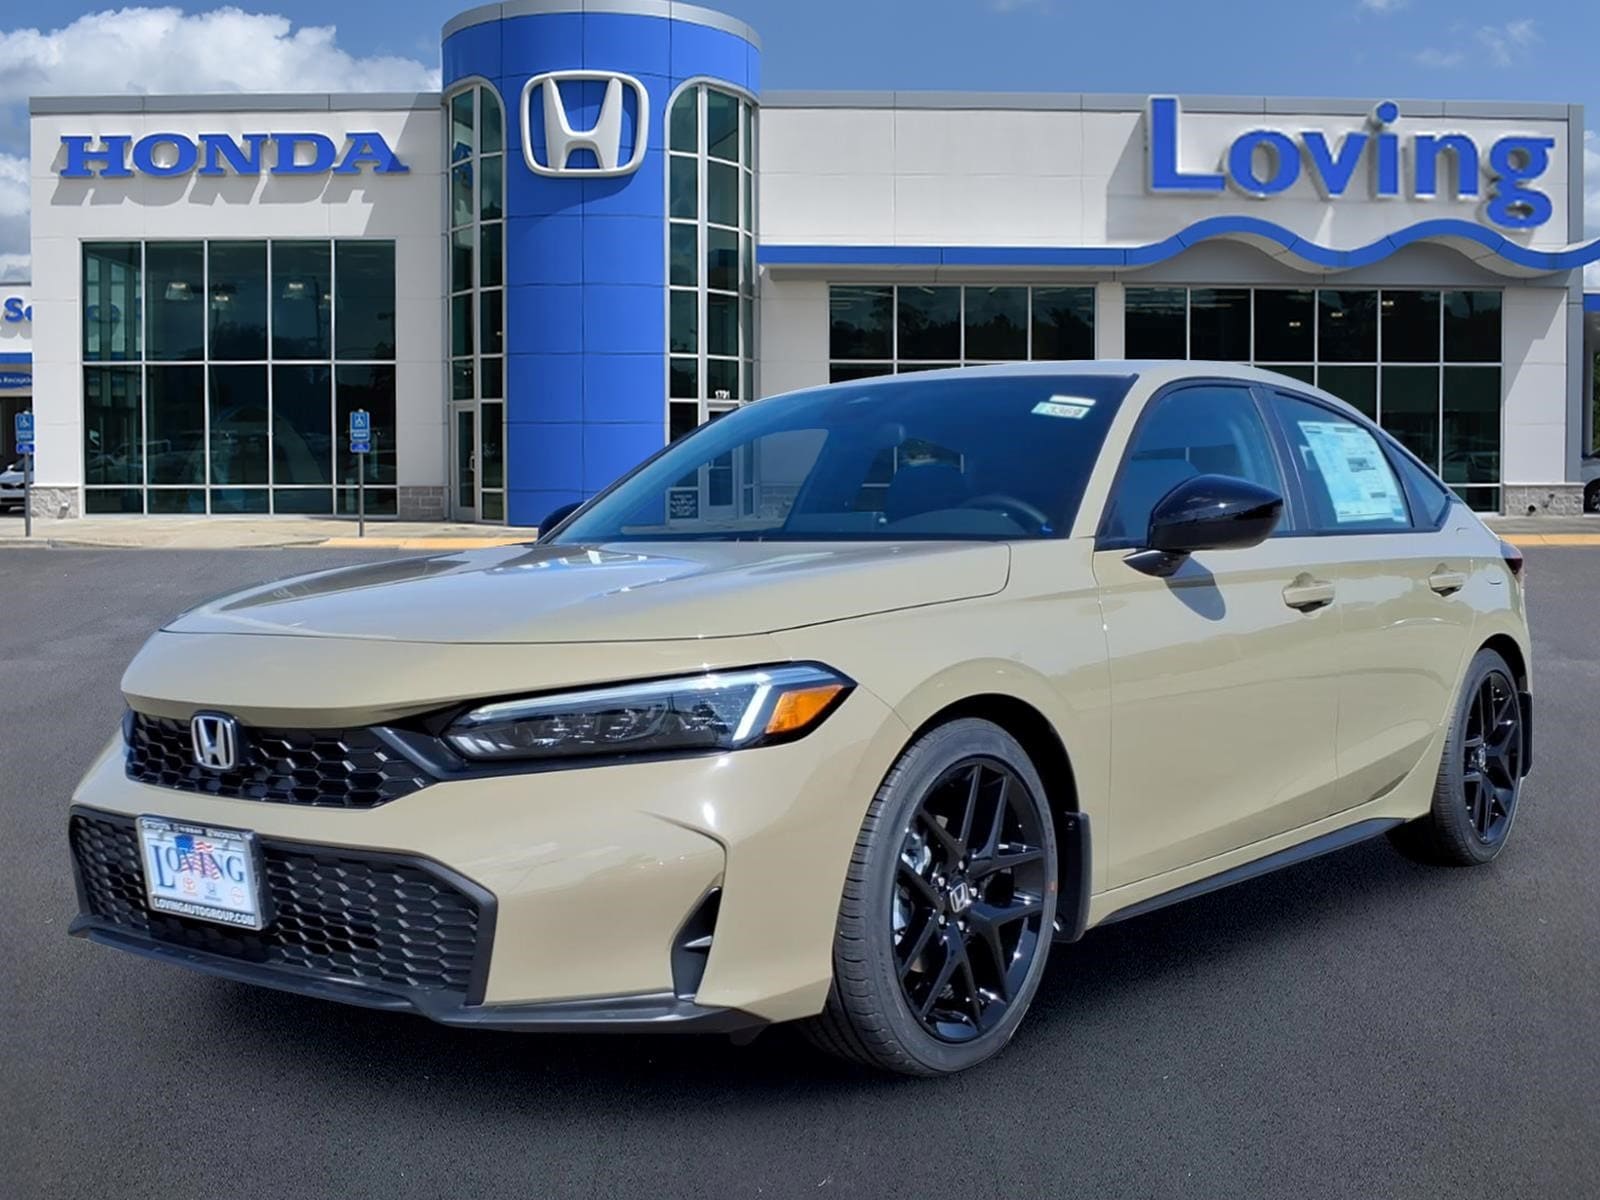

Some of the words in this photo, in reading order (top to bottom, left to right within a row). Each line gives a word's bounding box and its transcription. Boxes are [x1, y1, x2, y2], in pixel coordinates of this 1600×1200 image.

[60, 132, 409, 178] HONDA
[1150, 97, 1555, 229] Loving
[150, 844, 245, 889] LOVING
